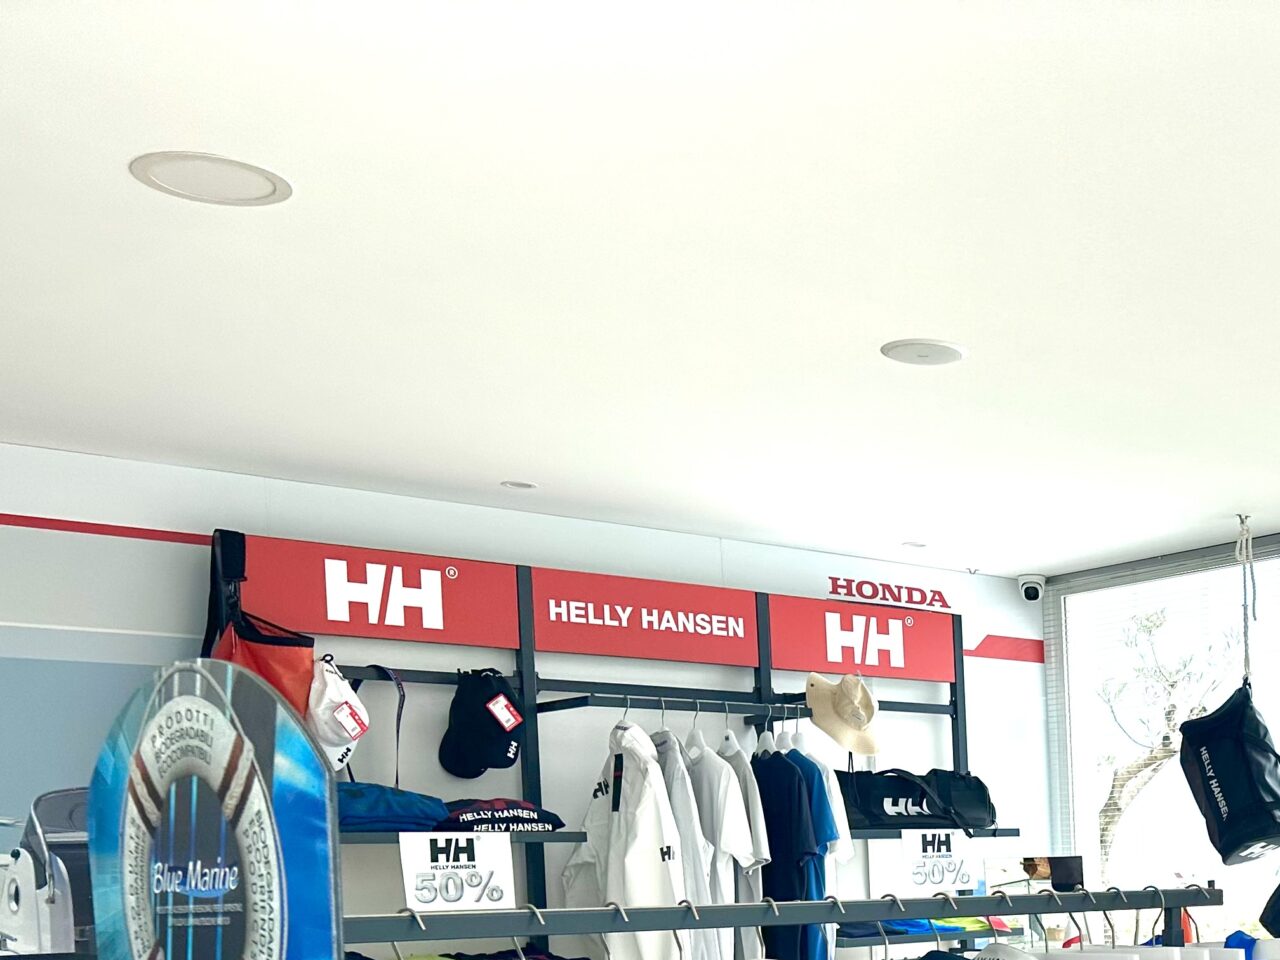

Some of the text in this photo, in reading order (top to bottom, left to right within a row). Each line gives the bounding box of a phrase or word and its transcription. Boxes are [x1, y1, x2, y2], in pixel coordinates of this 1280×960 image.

[827, 576, 951, 609] HONDA
[548, 599, 745, 638] HELLY HANSEN
[151, 708, 214, 746] PRODOTTI
[1200, 746, 1215, 777] HELLY
[459, 808, 538, 823] HELLY HANSEN
[473, 822, 553, 832] HELLY HANSEN
[153, 857, 238, 894] Blue Marine
[414, 871, 504, 903] 50%
[912, 858, 971, 885] 50%
